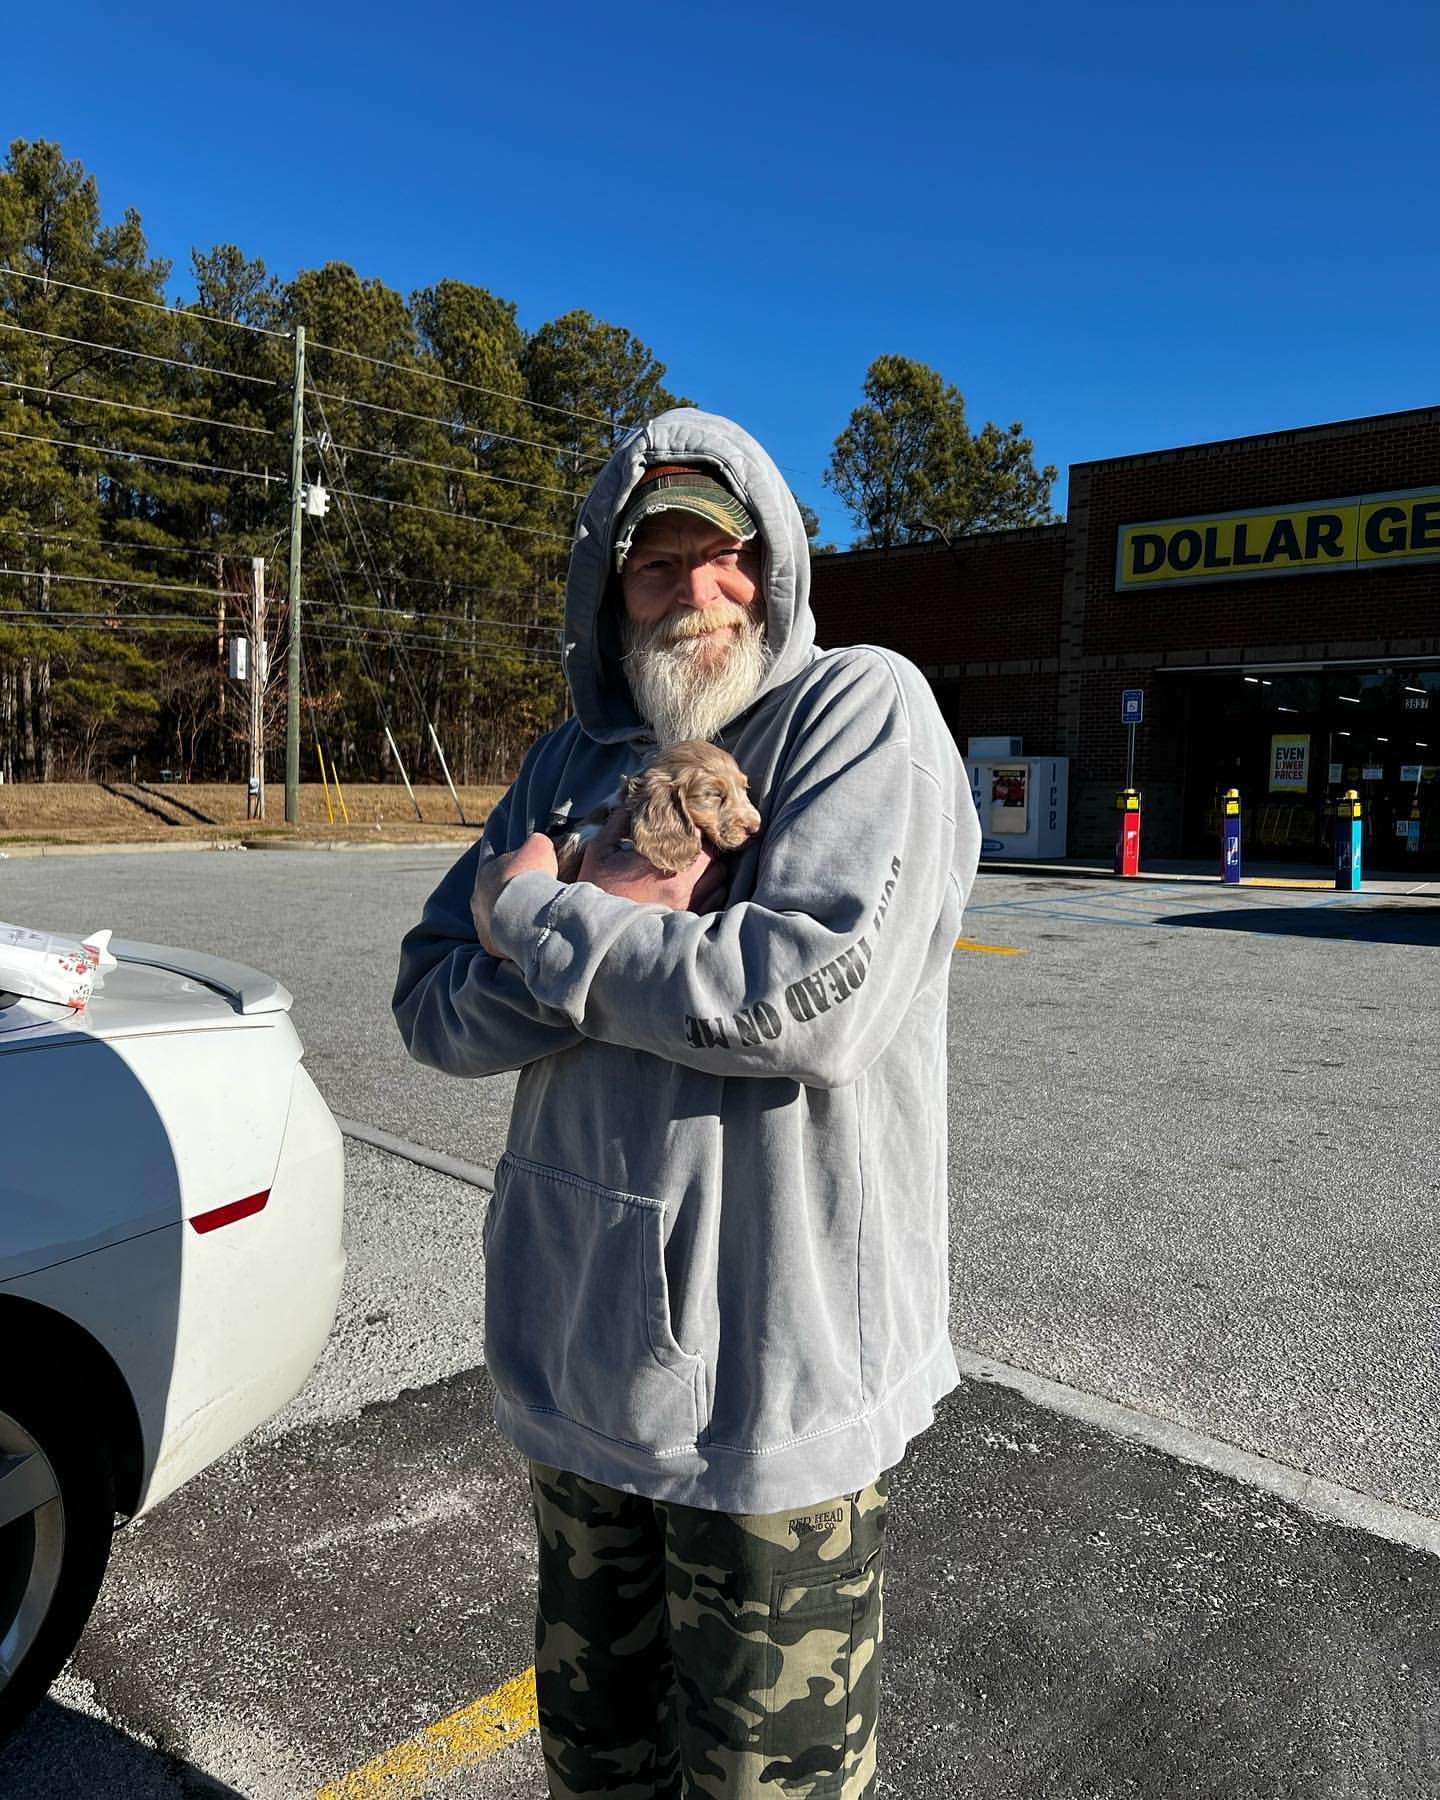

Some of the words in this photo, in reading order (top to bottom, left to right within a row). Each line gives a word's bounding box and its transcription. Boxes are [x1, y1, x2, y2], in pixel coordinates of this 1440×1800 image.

[1131, 514, 1344, 575] DOLLAR
[1364, 503, 1440, 553] GE
[1276, 747, 1305, 760] EVEN
[1276, 760, 1304, 770] LOWER
[1274, 770, 1304, 780] PRICES
[685, 1015, 730, 1048] ME
[733, 1001, 782, 1047] ON
[814, 1507, 843, 1523] HEAD
